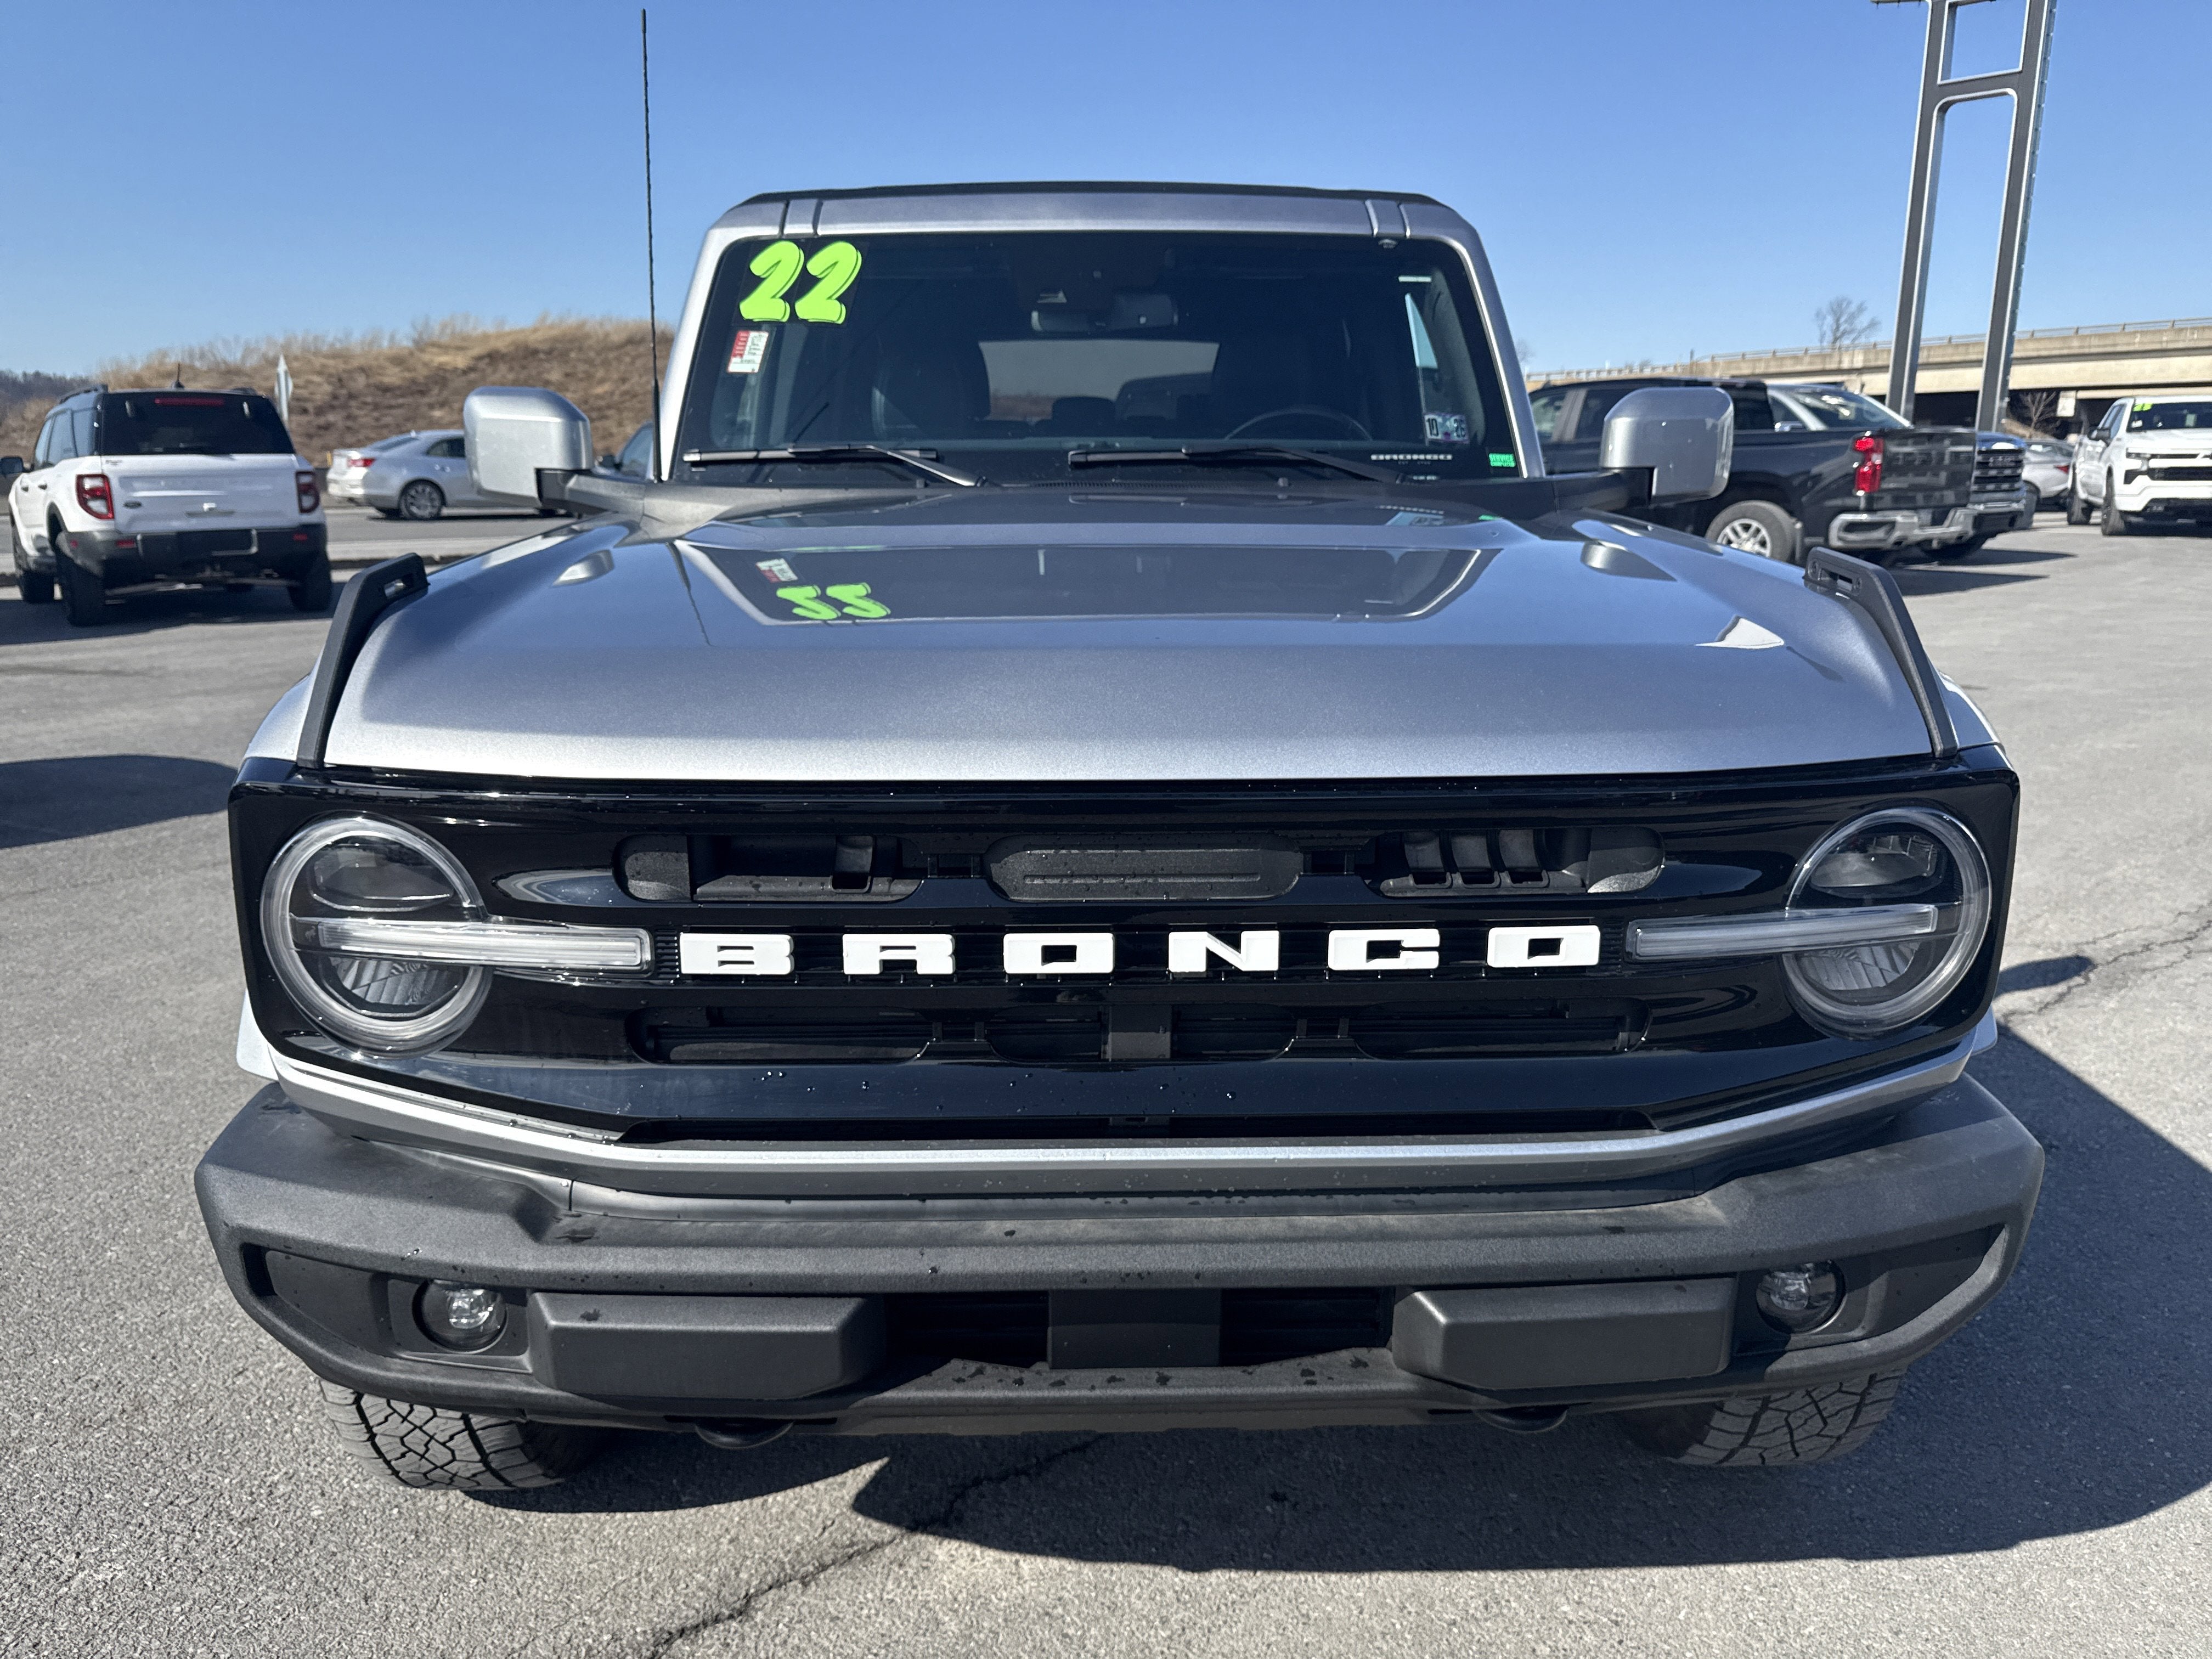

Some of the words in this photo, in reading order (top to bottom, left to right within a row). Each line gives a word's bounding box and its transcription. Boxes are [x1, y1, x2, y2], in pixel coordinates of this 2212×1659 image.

[739, 240, 862, 324] 22
[1426, 417, 1439, 437] 10
[680, 925, 1601, 975] BRONCO
